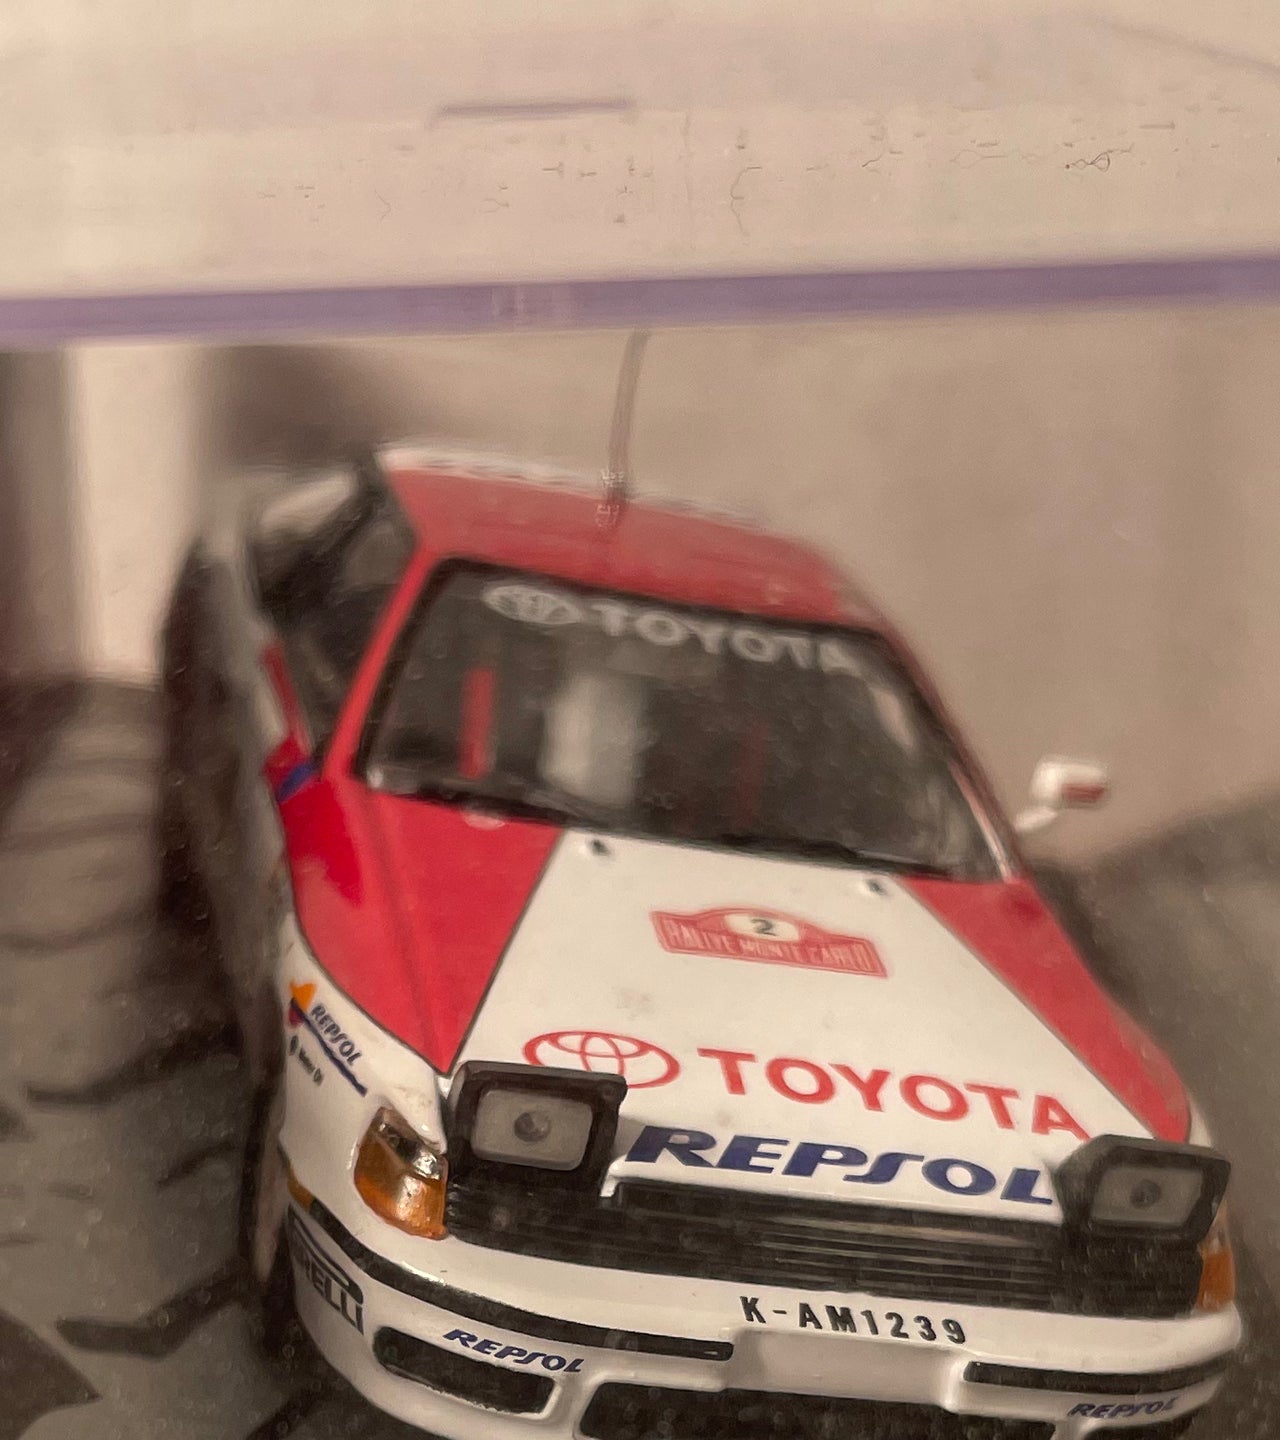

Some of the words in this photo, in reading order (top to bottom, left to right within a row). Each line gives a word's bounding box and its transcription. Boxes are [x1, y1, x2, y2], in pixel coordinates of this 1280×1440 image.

[589, 604, 862, 678] TOYOTA
[751, 916, 778, 937] 2
[311, 1003, 362, 1066] REPSOL
[696, 1046, 1091, 1141] TOYOTA
[624, 1124, 1055, 1206] REPSOL
[739, 1295, 967, 1345] K-AM1239
[443, 1328, 585, 1373] REPSOL
[1066, 1395, 1180, 1419] REPSOL
